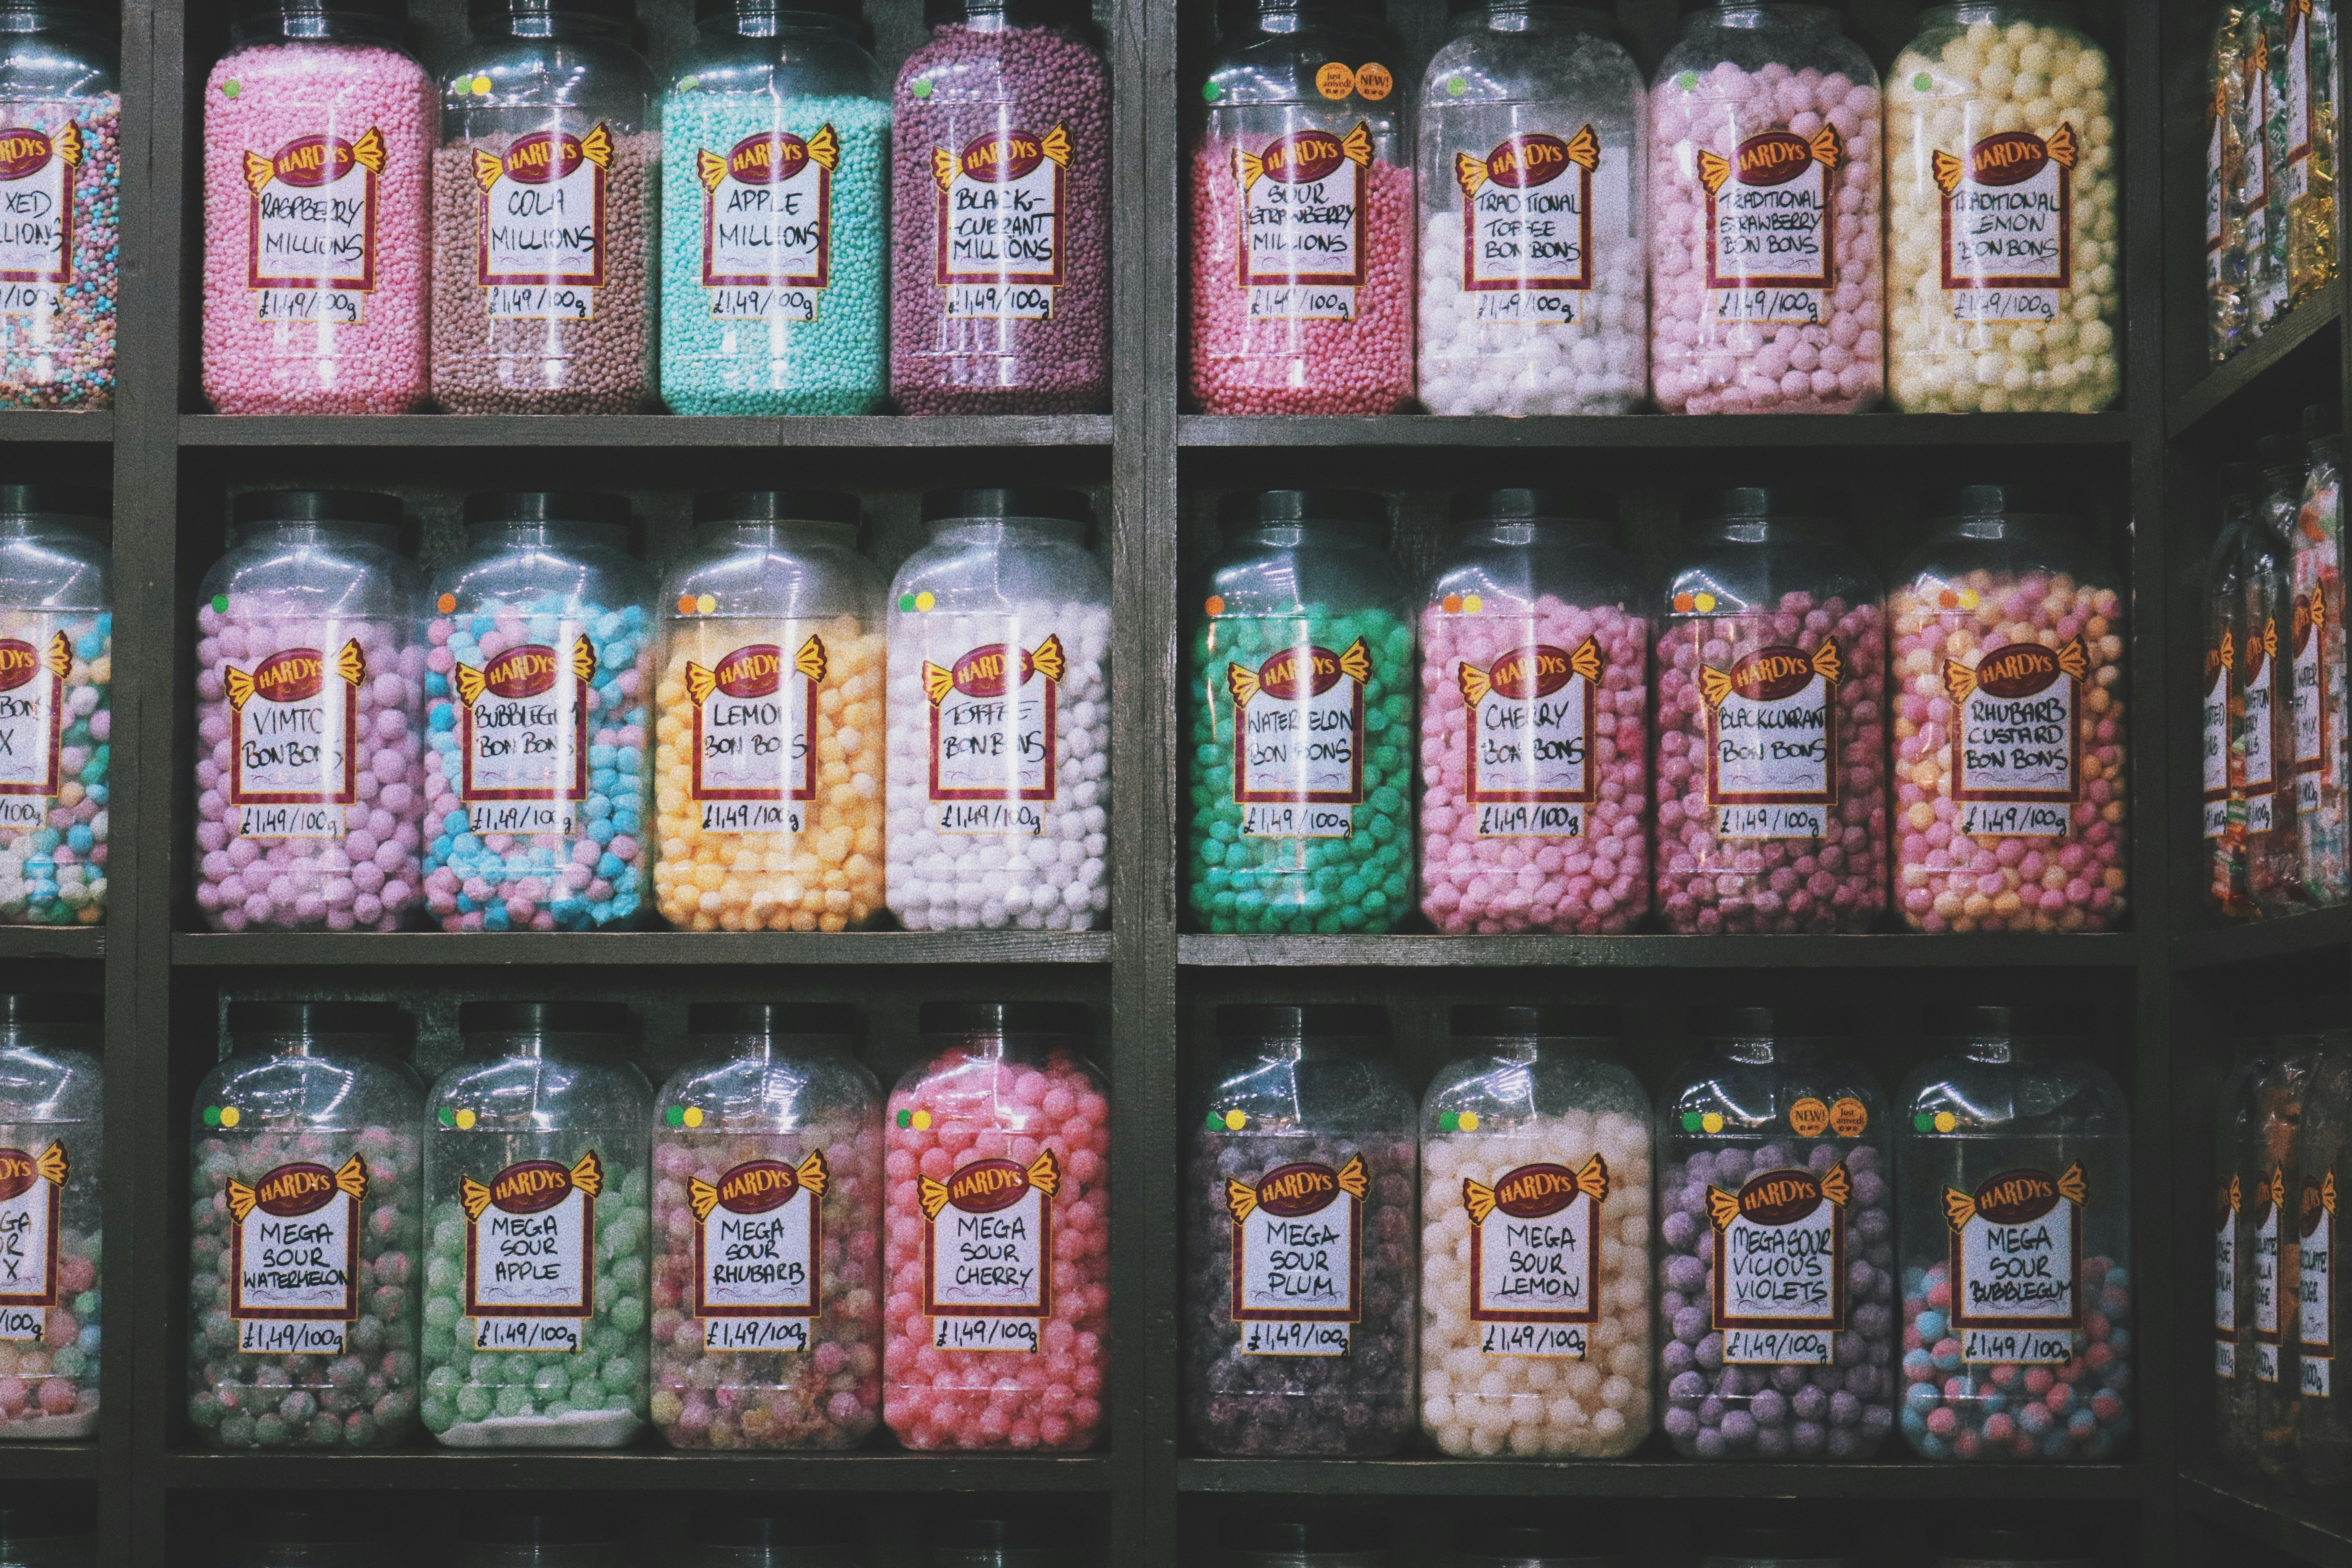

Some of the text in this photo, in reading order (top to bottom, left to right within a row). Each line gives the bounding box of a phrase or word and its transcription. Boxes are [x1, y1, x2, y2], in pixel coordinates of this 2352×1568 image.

[1361, 74, 1388, 87] NEW!
[1737, 142, 1805, 172] HARDYS
[1974, 142, 2042, 171] HARDYS
[509, 189, 564, 216] COLA
[1268, 182, 1329, 204] SOUR
[1475, 189, 1581, 214] TRADTIONAL
[1720, 213, 1824, 233] SRAWBERRY
[267, 233, 363, 261] MILLIONS
[492, 226, 596, 252] MILLIONS
[719, 221, 819, 254] MILLIONS
[1767, 235, 1818, 254] BONS
[2007, 238, 2059, 258] BONS
[1530, 241, 1581, 261] BONS
[713, 290, 813, 319] £1,49/00g
[490, 655, 557, 685] HARDYS
[721, 655, 780, 685] HARDY
[958, 654, 1028, 685] HARDS
[1737, 656, 1807, 687] HARDYS
[1982, 654, 2053, 683] HARDYS
[1248, 709, 1354, 734] WATERELON
[1971, 698, 2066, 725] RHUBARB
[476, 735, 516, 757] BON
[751, 734, 807, 759] BOS
[944, 731, 1047, 762] BON BNS
[1968, 725, 2063, 744] CUSTARD
[1296, 738, 1352, 764] ONS
[1534, 737, 1585, 764] BONS
[1771, 738, 1827, 762] BONS
[1965, 749, 2068, 770] BON BONS
[1796, 1110, 1825, 1121] NEW!
[1841, 1108, 1854, 1117] Just
[261, 1173, 330, 1202] HARDYS
[496, 1170, 565, 1200] HARDYS
[722, 1170, 792, 1200] HARDYS
[954, 1169, 1023, 1199] HARDYS
[1262, 1172, 1333, 1203] HARDYS
[1501, 1174, 1571, 1203] HARDYS
[1744, 1181, 1816, 1210] HARDYS
[1982, 1180, 2053, 1210] HARDYS
[261, 1223, 334, 1245] MEGA
[492, 1216, 557, 1237] MEGA
[721, 1218, 784, 1241] MEGA
[958, 1216, 1026, 1240] MEGA
[1267, 1221, 1340, 1247] MEGA
[1508, 1224, 1576, 1251] MEGA
[1988, 1225, 2052, 1252] MEGA
[501, 1237, 558, 1256] SOUR
[725, 1240, 780, 1260] SOUR
[960, 1242, 1019, 1262] SOUR
[1734, 1226, 1833, 1257] MEGA SOUR
[263, 1247, 330, 1268] SOUR
[1270, 1250, 1329, 1271] SOUR
[1510, 1250, 1567, 1274] SOUR
[1733, 1255, 1822, 1277] VICIOUS
[1990, 1256, 2051, 1279] SOUR
[244, 1270, 349, 1289] WATERMELON
[496, 1261, 561, 1281] APPLE
[713, 1263, 805, 1285] RHUBARB
[956, 1265, 1033, 1288] CHERRY
[1268, 1272, 1333, 1296] PLUM
[1501, 1276, 1579, 1296] LEMON
[1736, 1279, 1828, 1302] VIOLETS
[1969, 1281, 2072, 1302] BUBBLEGUM
